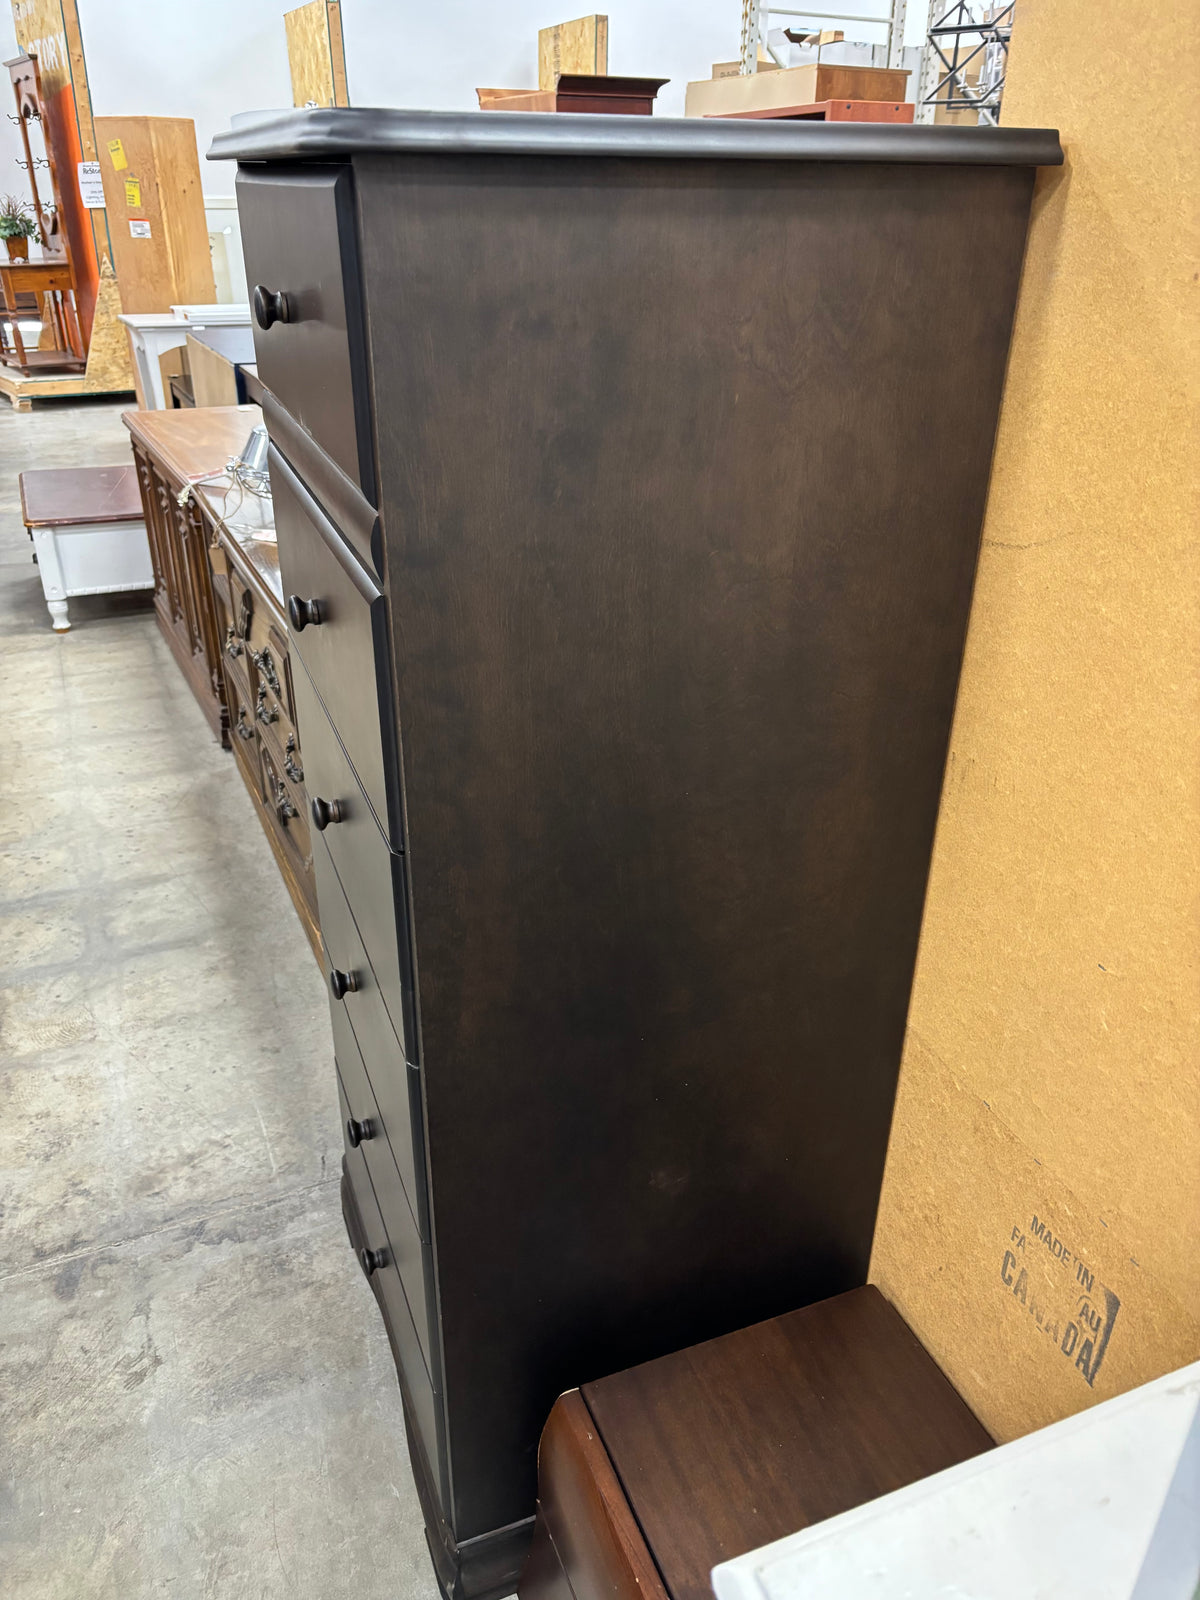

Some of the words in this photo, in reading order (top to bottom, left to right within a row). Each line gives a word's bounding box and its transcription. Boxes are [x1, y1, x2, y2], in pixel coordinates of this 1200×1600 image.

[1030, 1214, 1071, 1268] MADE
[1076, 1262, 1095, 1293] IN
[1079, 1302, 1102, 1332] AU
